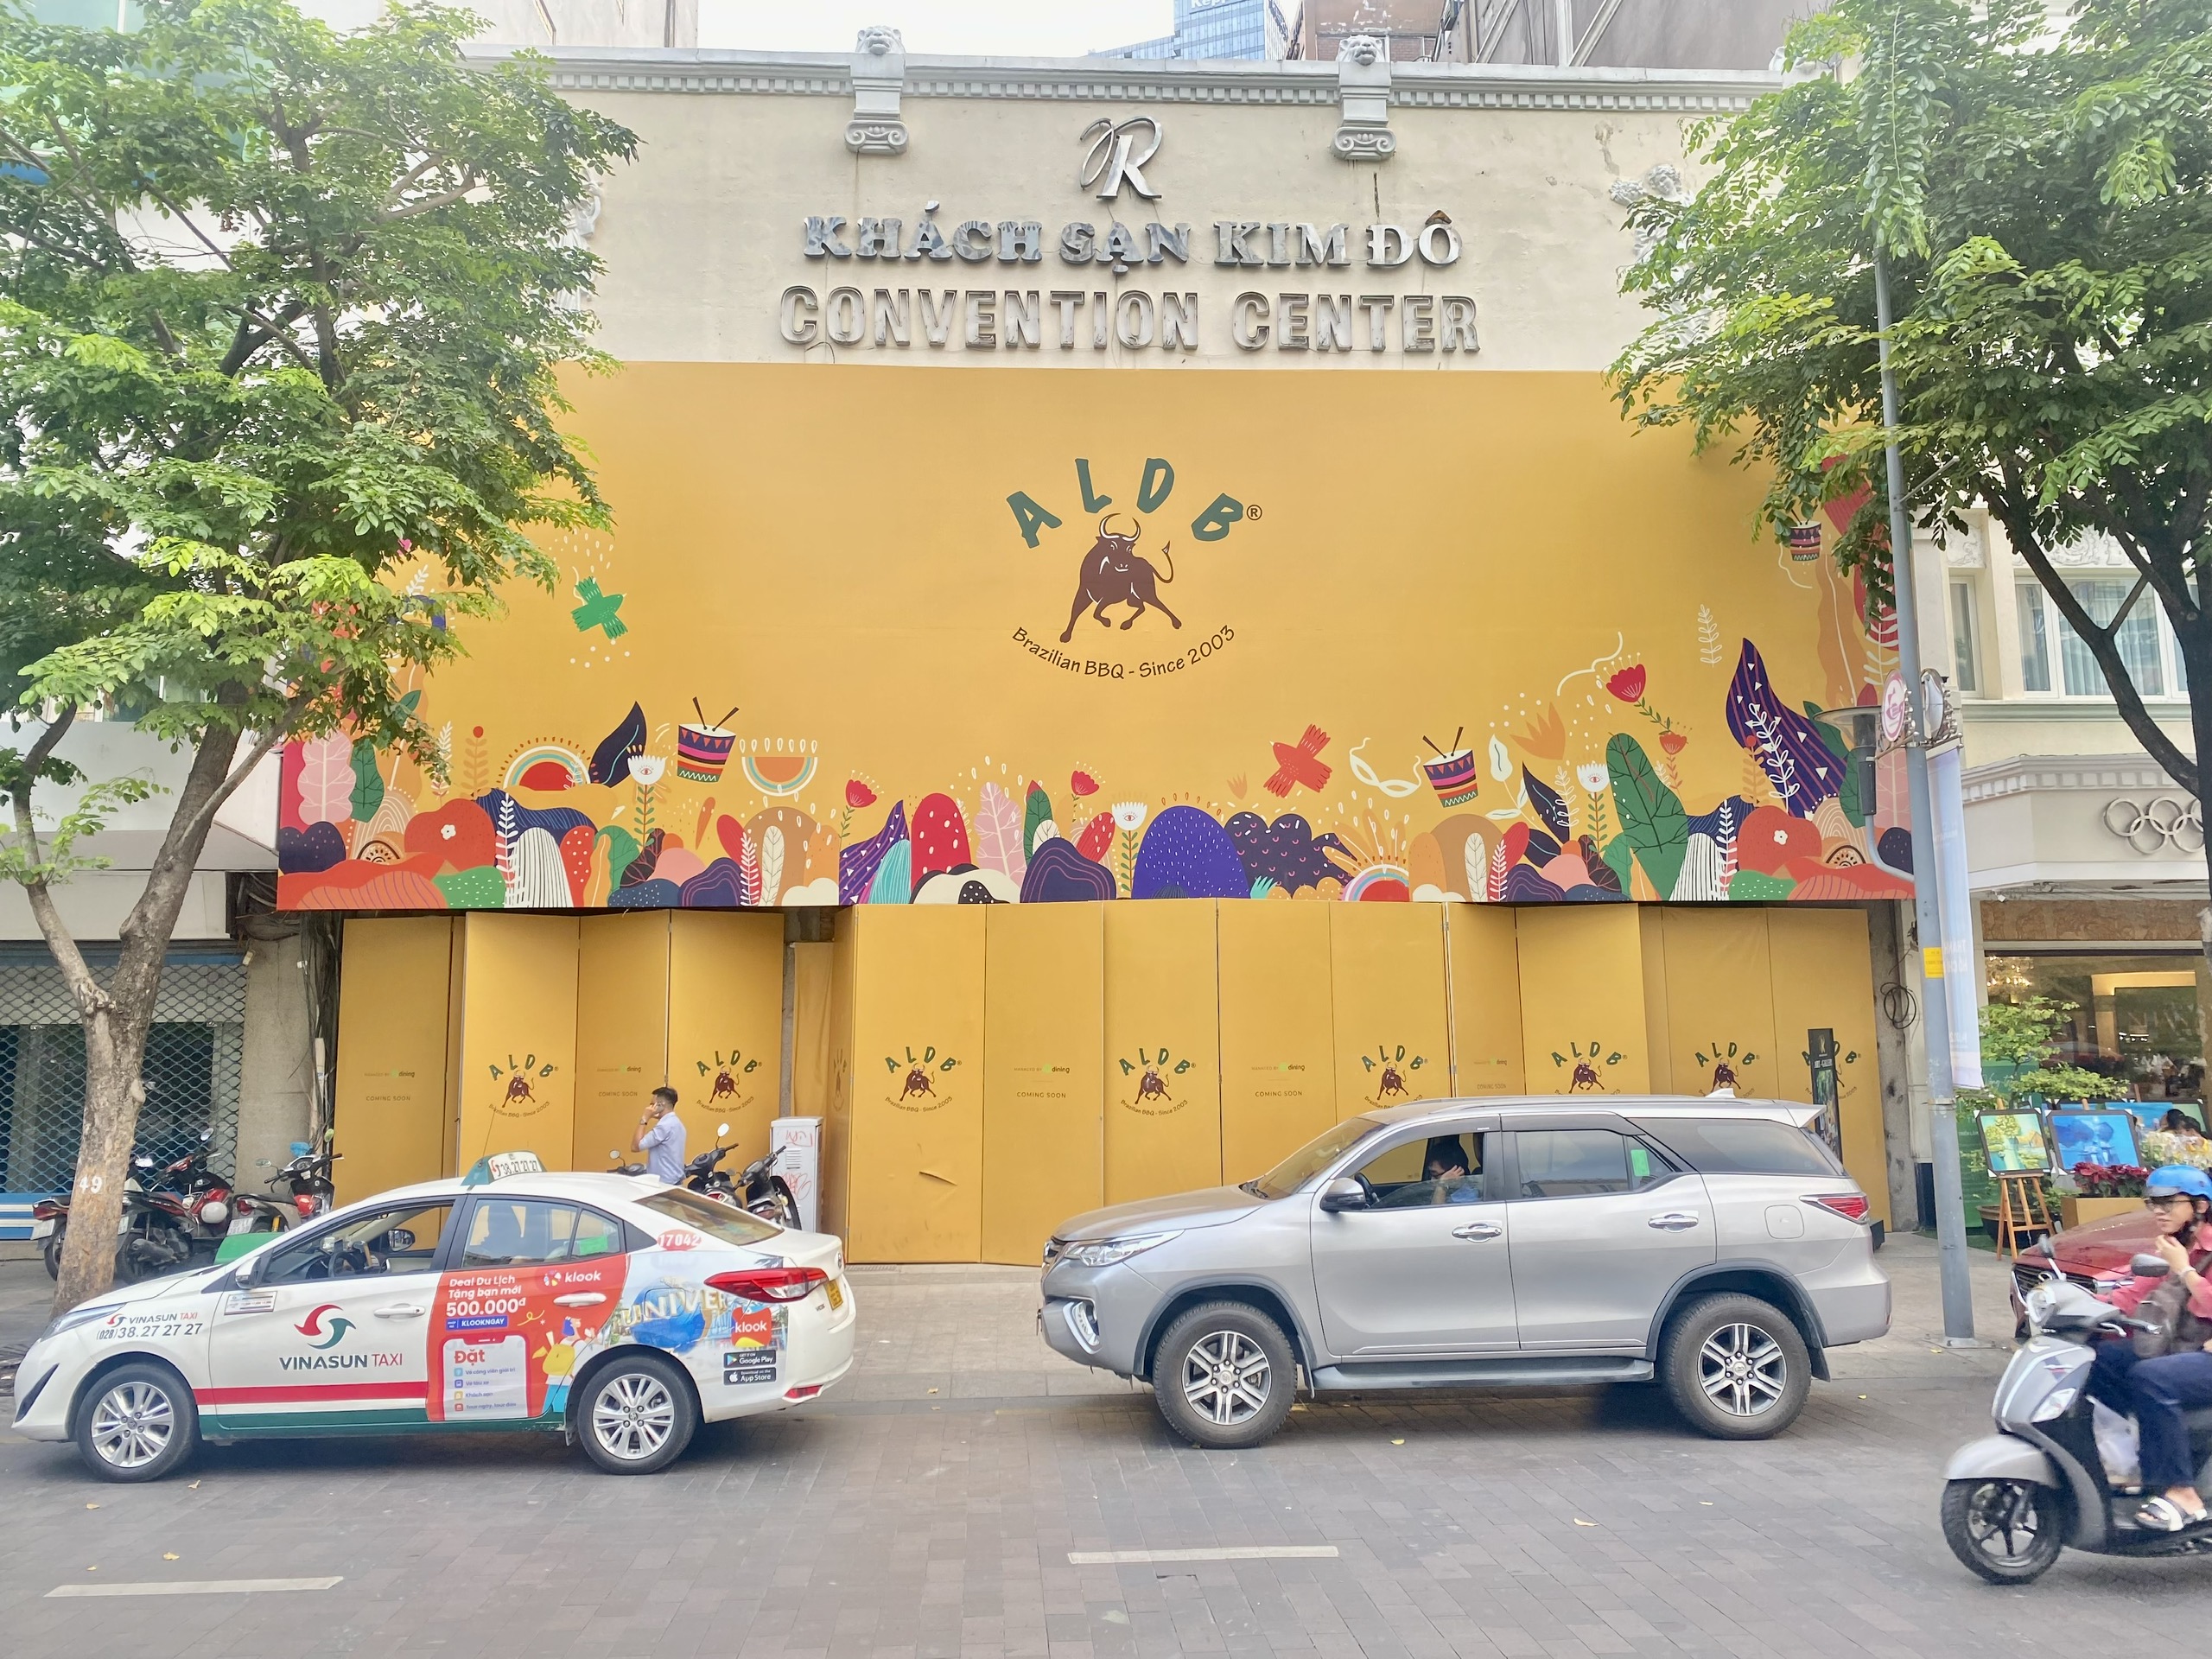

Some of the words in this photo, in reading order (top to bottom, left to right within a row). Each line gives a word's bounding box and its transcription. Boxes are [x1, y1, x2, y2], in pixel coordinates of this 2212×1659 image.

[804, 200, 1043, 263] KHÁCH
[1059, 221, 1192, 275] SẠN
[1213, 221, 1351, 267] KIM
[1366, 210, 1463, 267] ĐÔ
[780, 285, 1198, 351] CONVENTION
[1232, 290, 1481, 353] CENTER
[1012, 627, 1080, 672] Brazilian
[1084, 661, 1124, 680] BBQ
[1139, 657, 1185, 678] Since
[1187, 625, 1236, 664] 2003
[79, 1175, 103, 1193] 49
[658, 1233, 701, 1248] 17042
[449, 1276, 474, 1287] Deal
[476, 1276, 490, 1286] Du
[493, 1274, 515, 1287] Lịch
[564, 1270, 601, 1283] klook
[448, 1288, 474, 1300] Tặng
[477, 1287, 499, 1298] bạn
[499, 1286, 522, 1296] mới
[129, 1313, 177, 1325] VINASUN
[180, 1312, 198, 1320] TAXI
[461, 1318, 505, 1327] KLOOKNGAY
[162, 1324, 182, 1336] 27
[184, 1323, 203, 1336] 27
[734, 1320, 767, 1333] klook
[279, 1354, 368, 1370] VINASUN
[372, 1353, 403, 1367] TAXI
[454, 1349, 486, 1366] Đặt
[740, 1357, 760, 1365] Google
